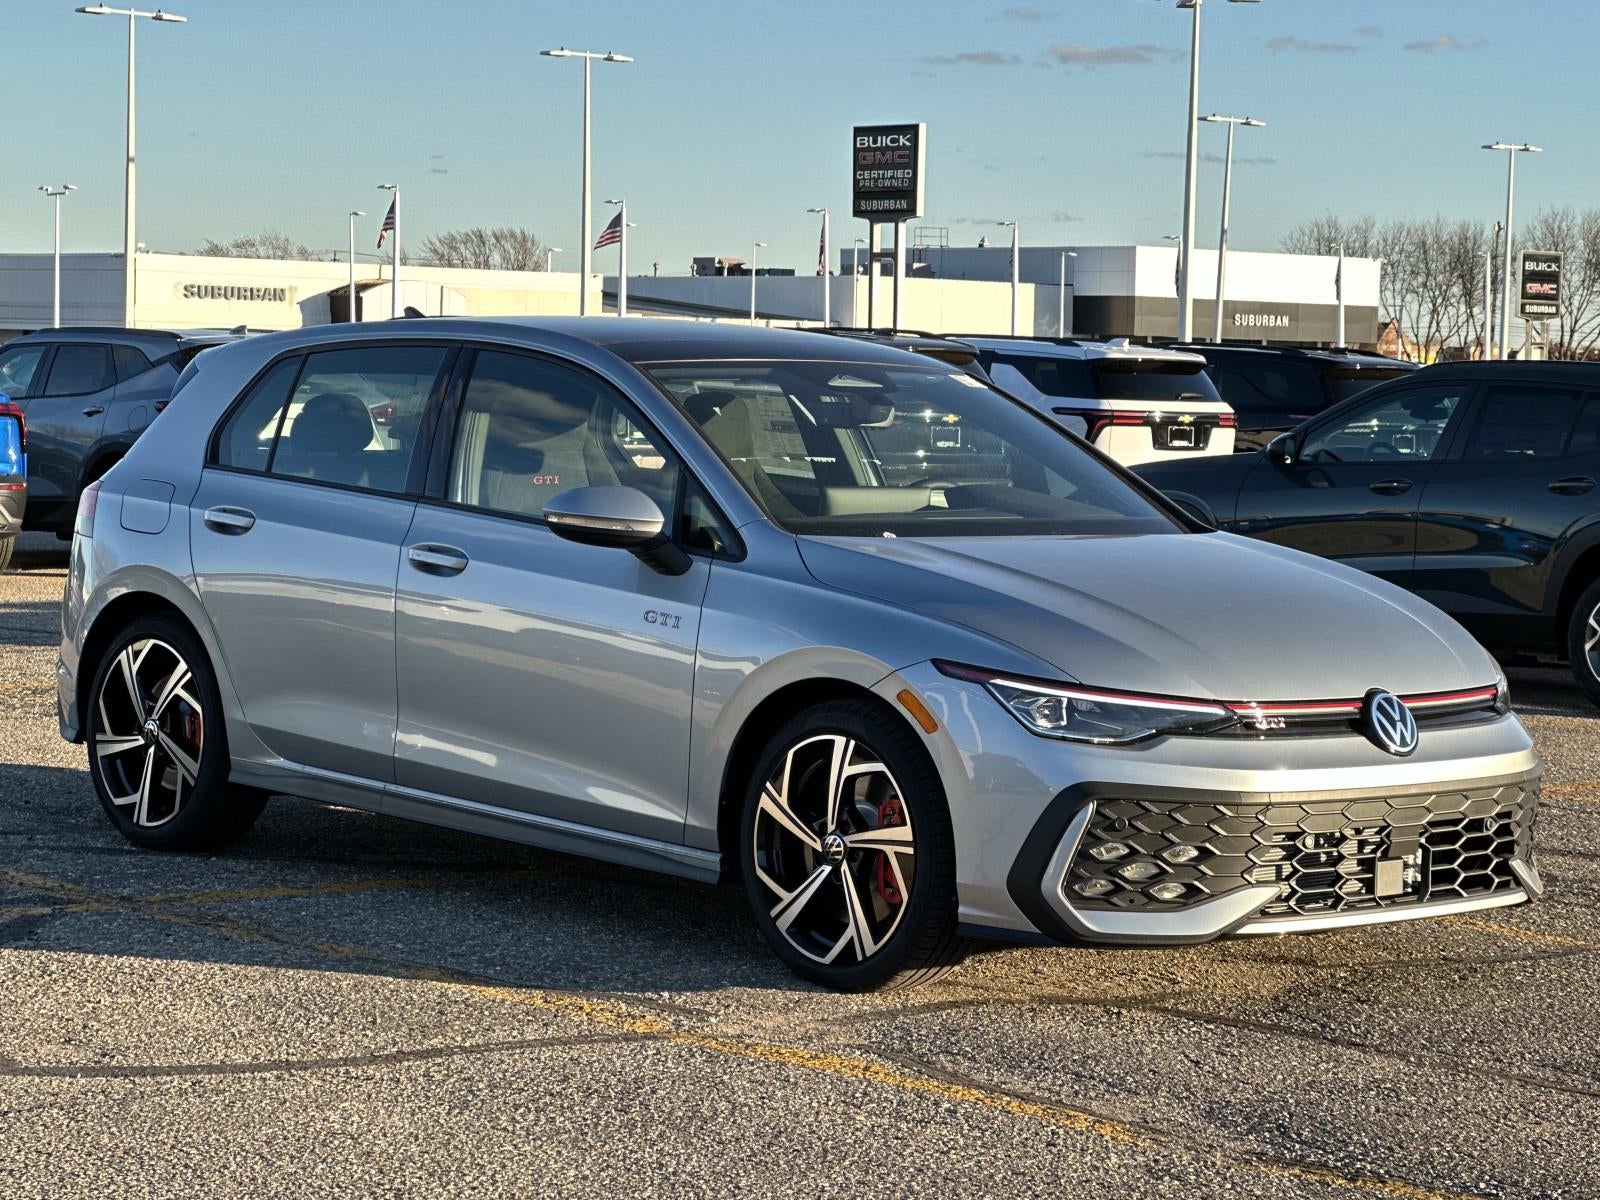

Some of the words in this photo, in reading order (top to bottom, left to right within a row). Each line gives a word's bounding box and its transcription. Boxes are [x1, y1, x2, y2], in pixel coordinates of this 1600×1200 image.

[856, 134, 912, 148] BUICK
[858, 150, 910, 165] GMC
[856, 169, 913, 179] CERTIFIED
[859, 178, 909, 187] PRE-OWNED
[860, 199, 907, 210] SUBURBAN
[1525, 261, 1560, 271] BUICK
[183, 283, 287, 302] SUBURBAN
[1526, 283, 1557, 294] GMC
[1525, 304, 1557, 314] SUBURBAN
[1233, 313, 1289, 327] SUBURBAN
[533, 475, 560, 485] GTI
[643, 609, 682, 629] GTI
